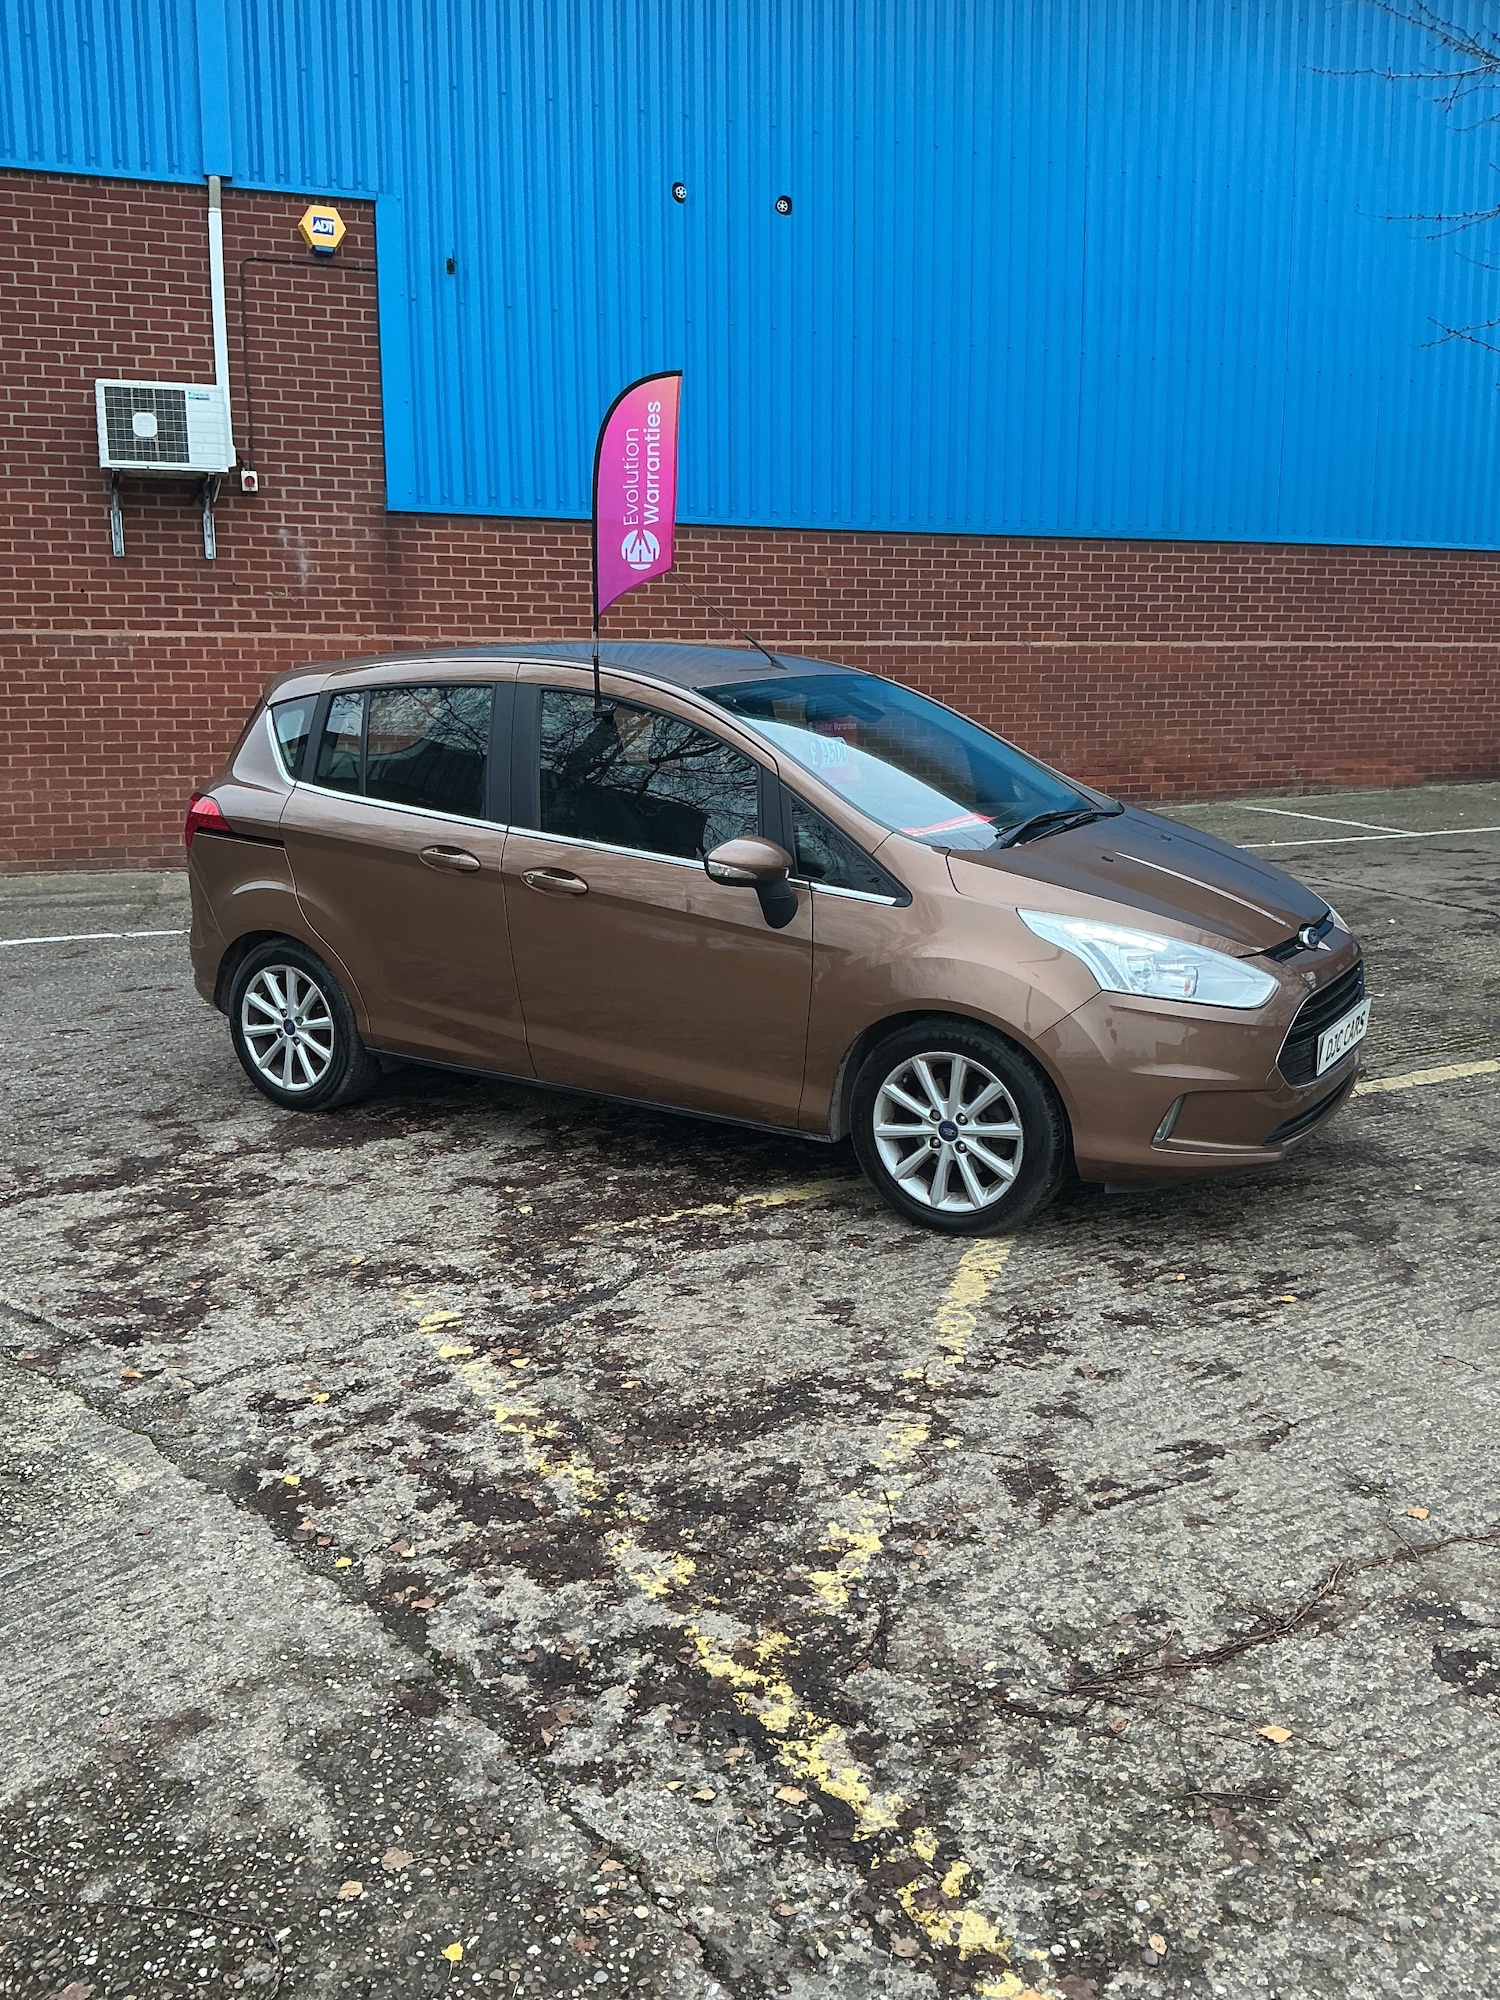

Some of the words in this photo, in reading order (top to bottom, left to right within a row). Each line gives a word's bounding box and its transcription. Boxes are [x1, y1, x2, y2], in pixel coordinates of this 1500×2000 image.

[313, 219, 334, 233] ADT
[622, 428, 639, 525] Evolution
[643, 401, 661, 525] Warranties
[1344, 1011, 1365, 1046] CARS
